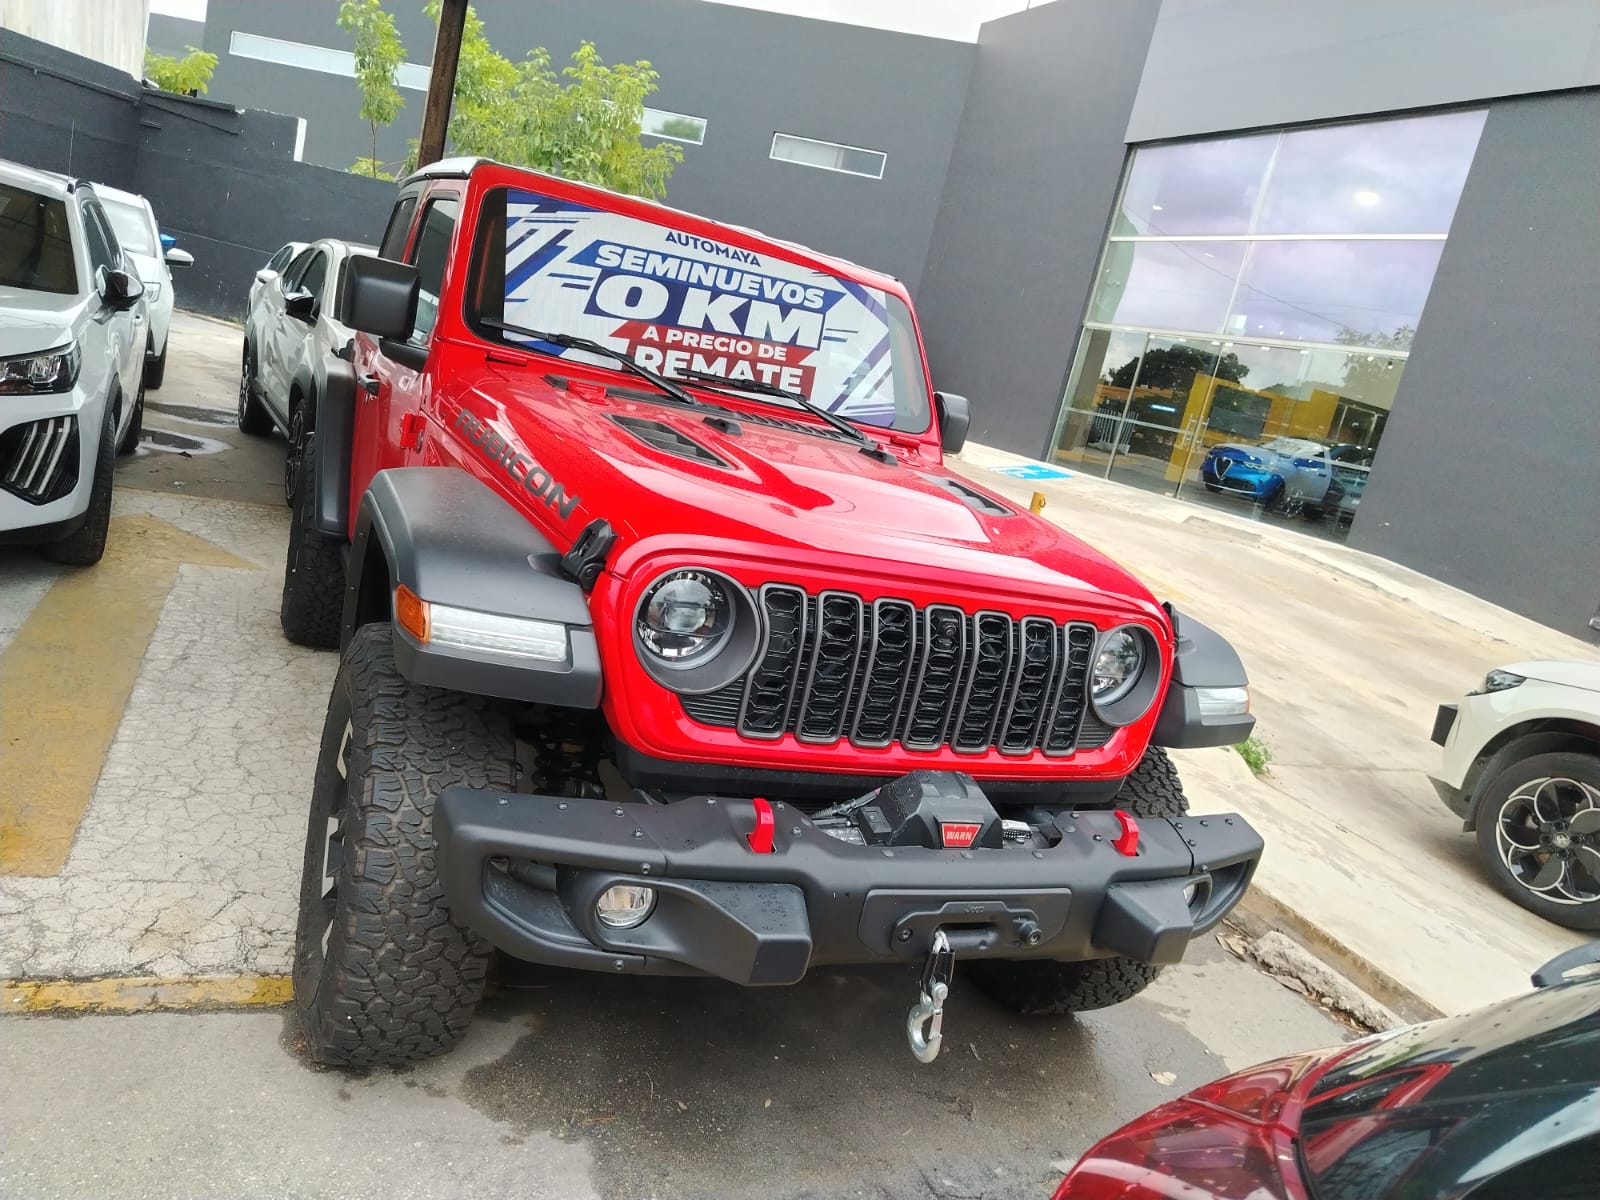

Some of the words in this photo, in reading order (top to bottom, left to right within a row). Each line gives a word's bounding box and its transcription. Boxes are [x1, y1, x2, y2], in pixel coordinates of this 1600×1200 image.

[665, 231, 762, 267] AUTOMAYA
[595, 244, 825, 309] SEMINUEVOS
[677, 286, 824, 349] KM
[642, 325, 659, 342] A
[665, 329, 753, 356] PRECIO
[758, 343, 788, 361] DE
[634, 345, 803, 395] REMATE
[455, 408, 582, 520] RUBICON
[946, 831, 972, 841] WARN
